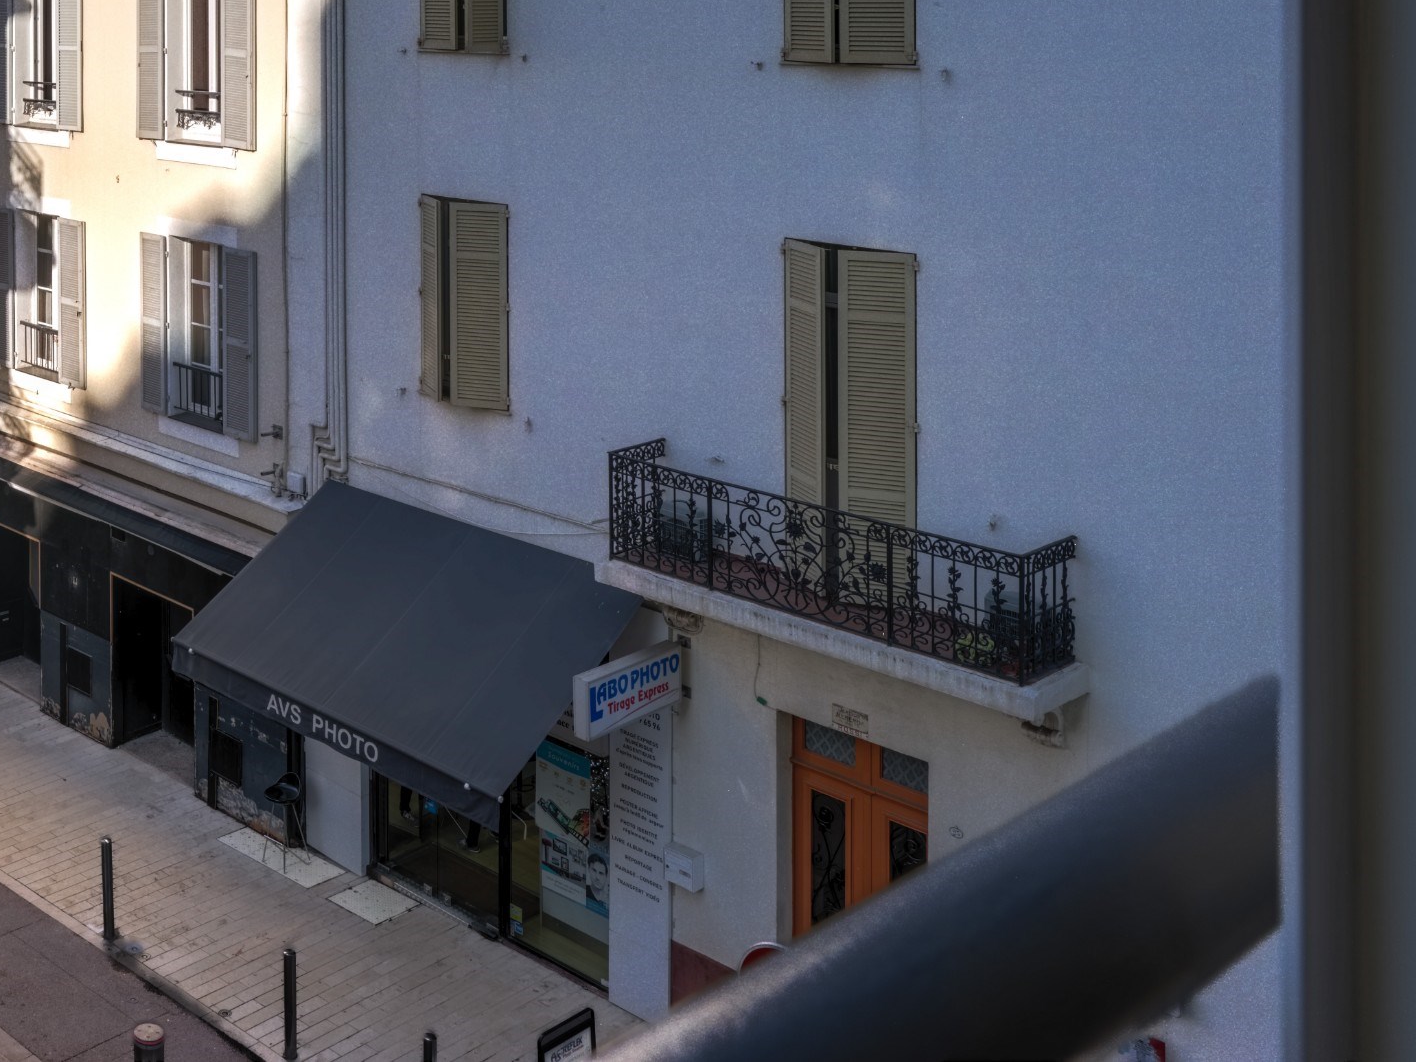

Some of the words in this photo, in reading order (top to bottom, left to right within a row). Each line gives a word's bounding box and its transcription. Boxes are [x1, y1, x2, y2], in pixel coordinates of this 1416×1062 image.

[589, 675, 628, 723] LABO
[630, 653, 680, 690] PHOTO
[607, 694, 635, 715] Tirage
[638, 682, 669, 703] Express
[266, 694, 302, 725] AVS
[312, 714, 379, 763] PHOTO
[547, 751, 580, 771] Souvenirs
